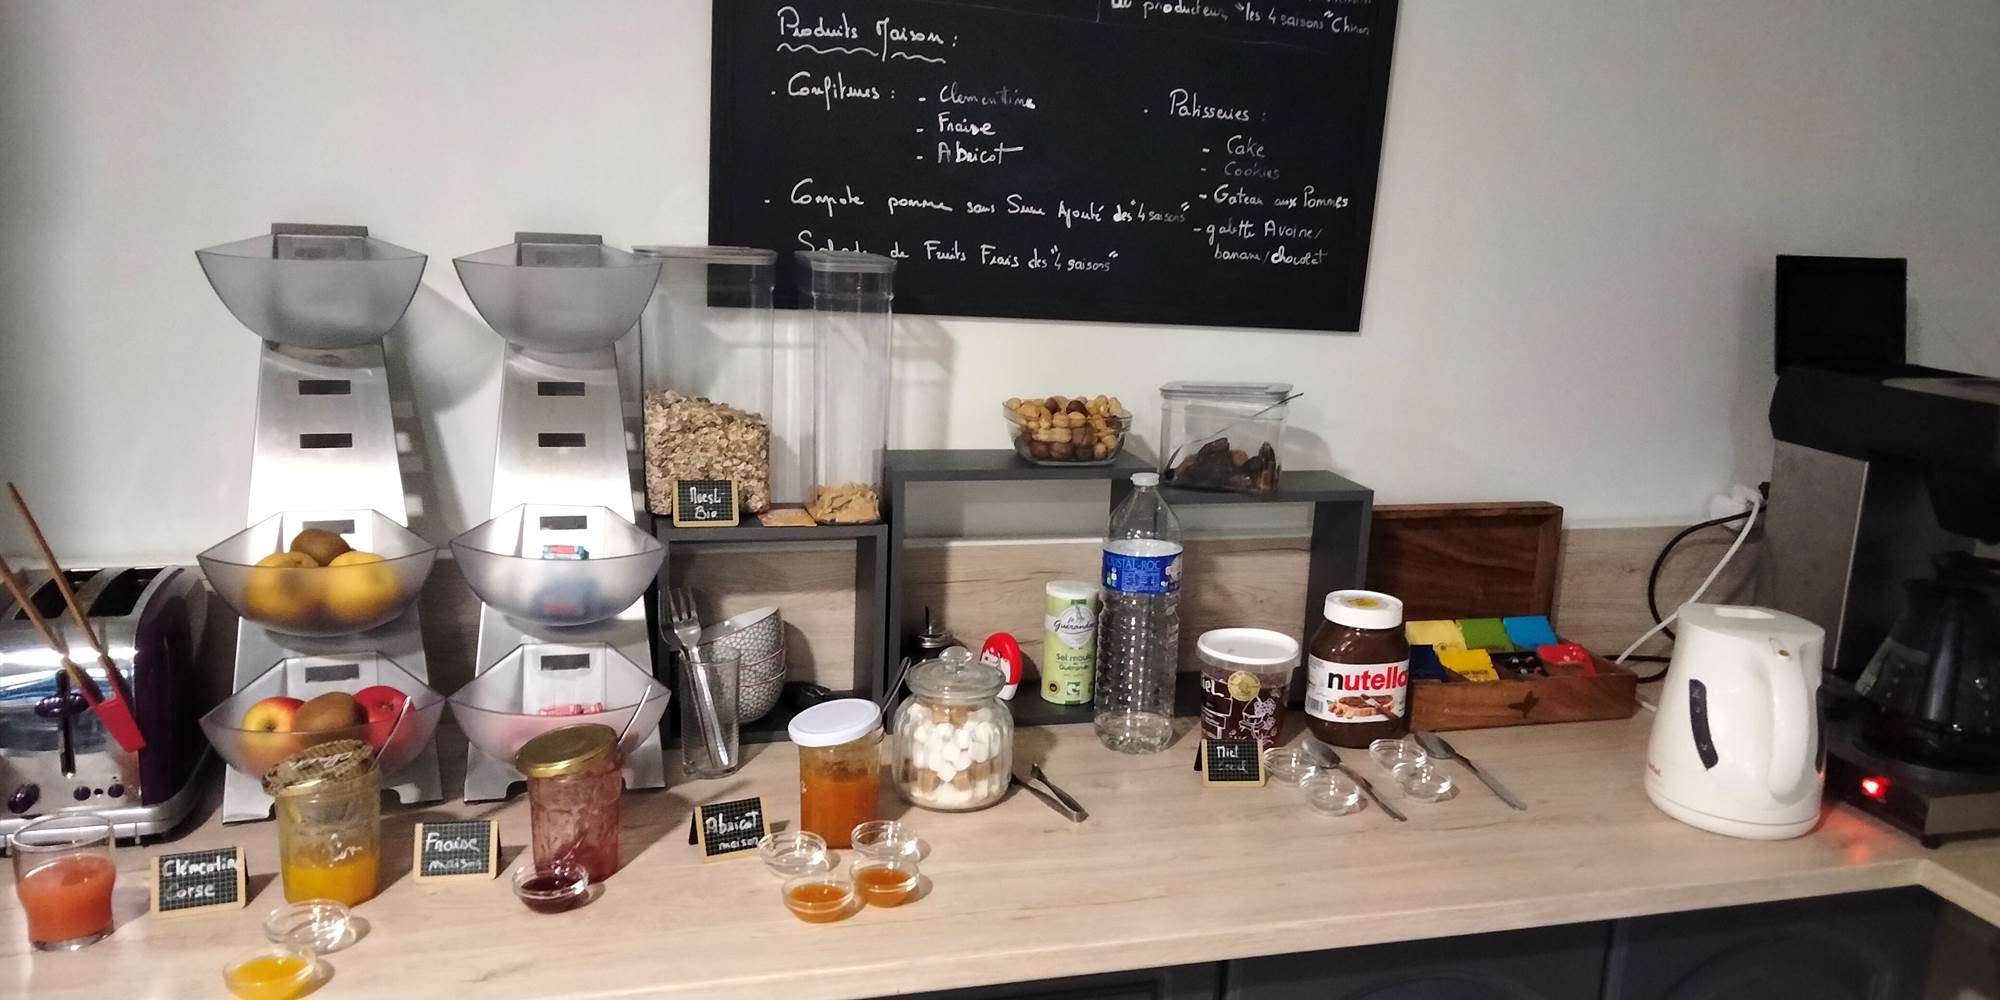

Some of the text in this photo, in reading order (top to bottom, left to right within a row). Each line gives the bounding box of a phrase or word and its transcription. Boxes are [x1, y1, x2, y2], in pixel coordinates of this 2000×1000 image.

[777, 6, 859, 39] Produits
[1169, 88, 1250, 121] Patisseries
[938, 112, 996, 135] Fraise
[937, 141, 1024, 164] Abricot
[1226, 135, 1266, 158] Cake
[1224, 161, 1281, 180] Cookies
[791, 178, 865, 217] Compote
[888, 197, 953, 215] pomme
[967, 202, 996, 214] sans
[1058, 200, 1105, 229] Ajouté
[1214, 184, 1349, 209] Gateau aux Pommes
[890, 241, 911, 259] de
[924, 240, 966, 262] Fruits
[980, 244, 1020, 268] Frais
[1028, 248, 1048, 269] des
[695, 505, 718, 520] Bio
[1216, 745, 1239, 758] Miel
[705, 811, 760, 834] Abricot
[425, 832, 480, 852] Fraise
[718, 837, 760, 851] maison
[166, 882, 216, 900] Corse
